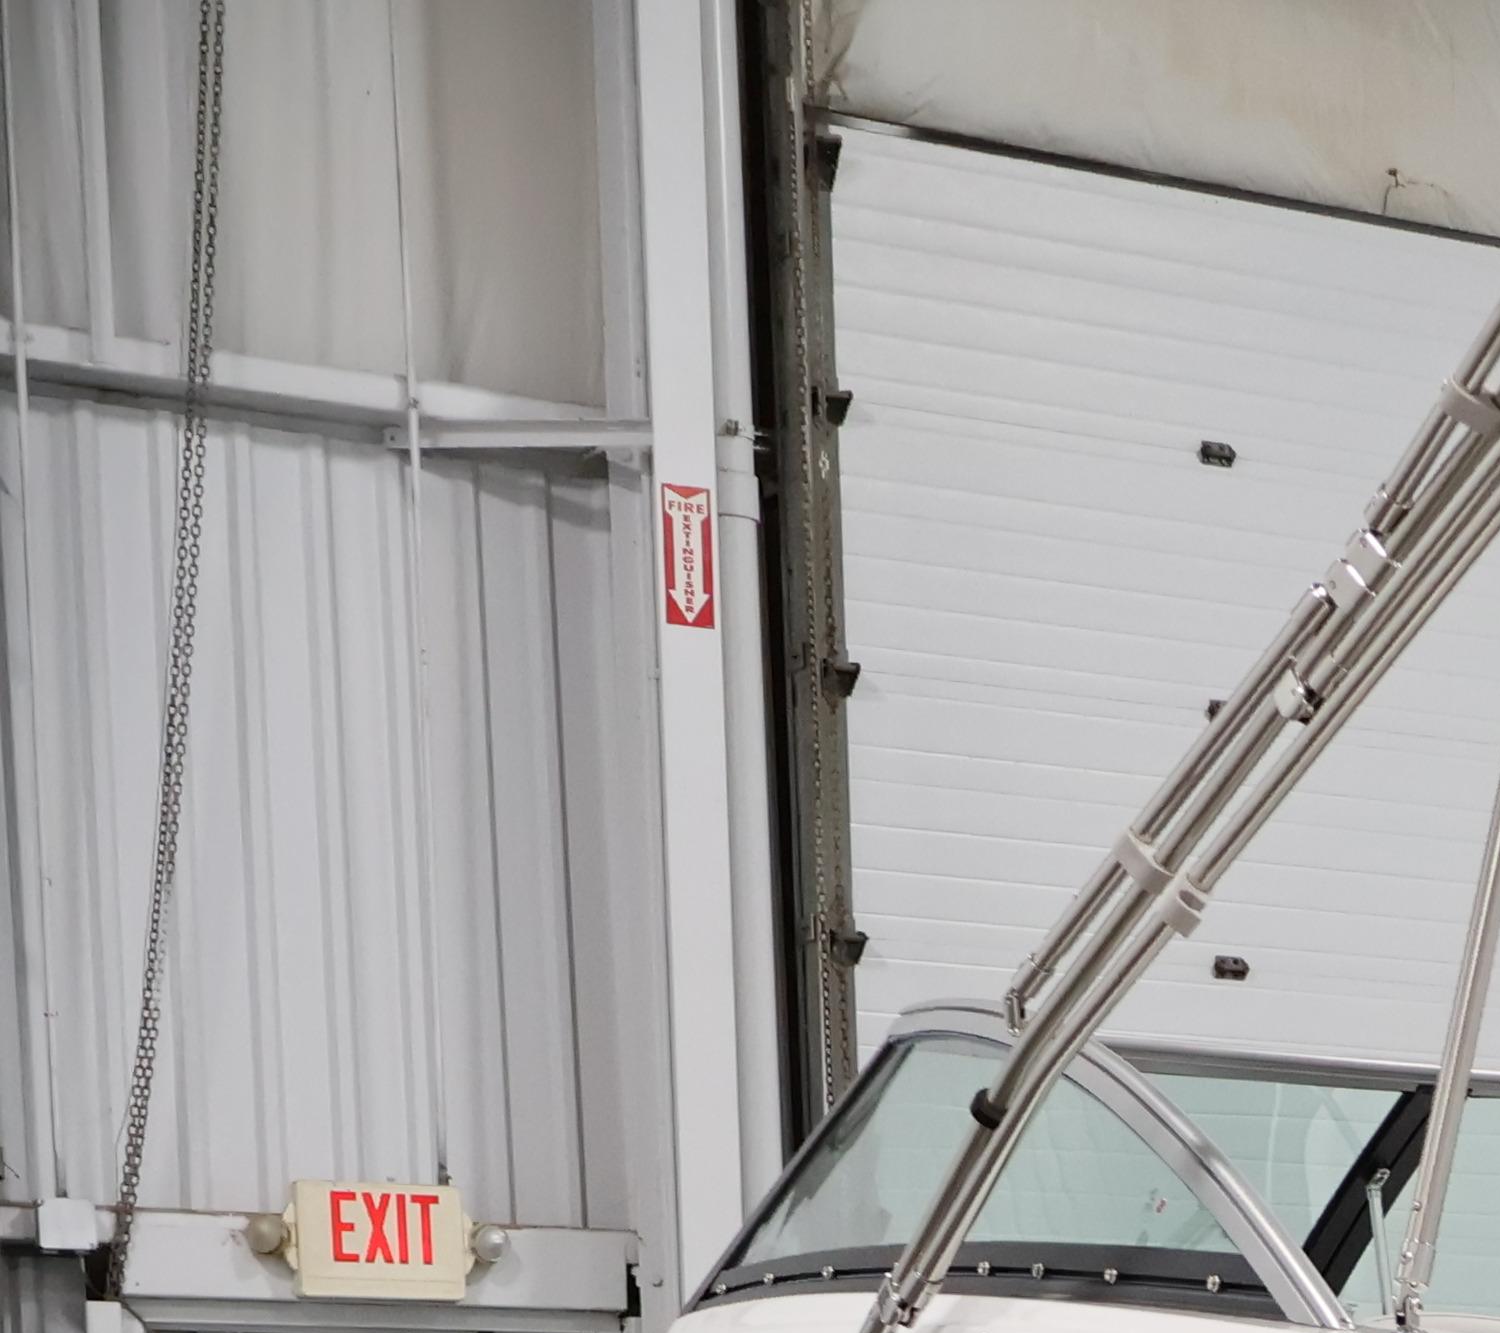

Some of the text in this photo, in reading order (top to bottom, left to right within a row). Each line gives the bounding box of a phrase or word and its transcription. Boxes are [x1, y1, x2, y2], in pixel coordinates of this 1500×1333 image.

[668, 500, 705, 514] FIRE
[682, 514, 695, 613] EXTINGUISHER
[330, 1190, 439, 1265] EXIT
